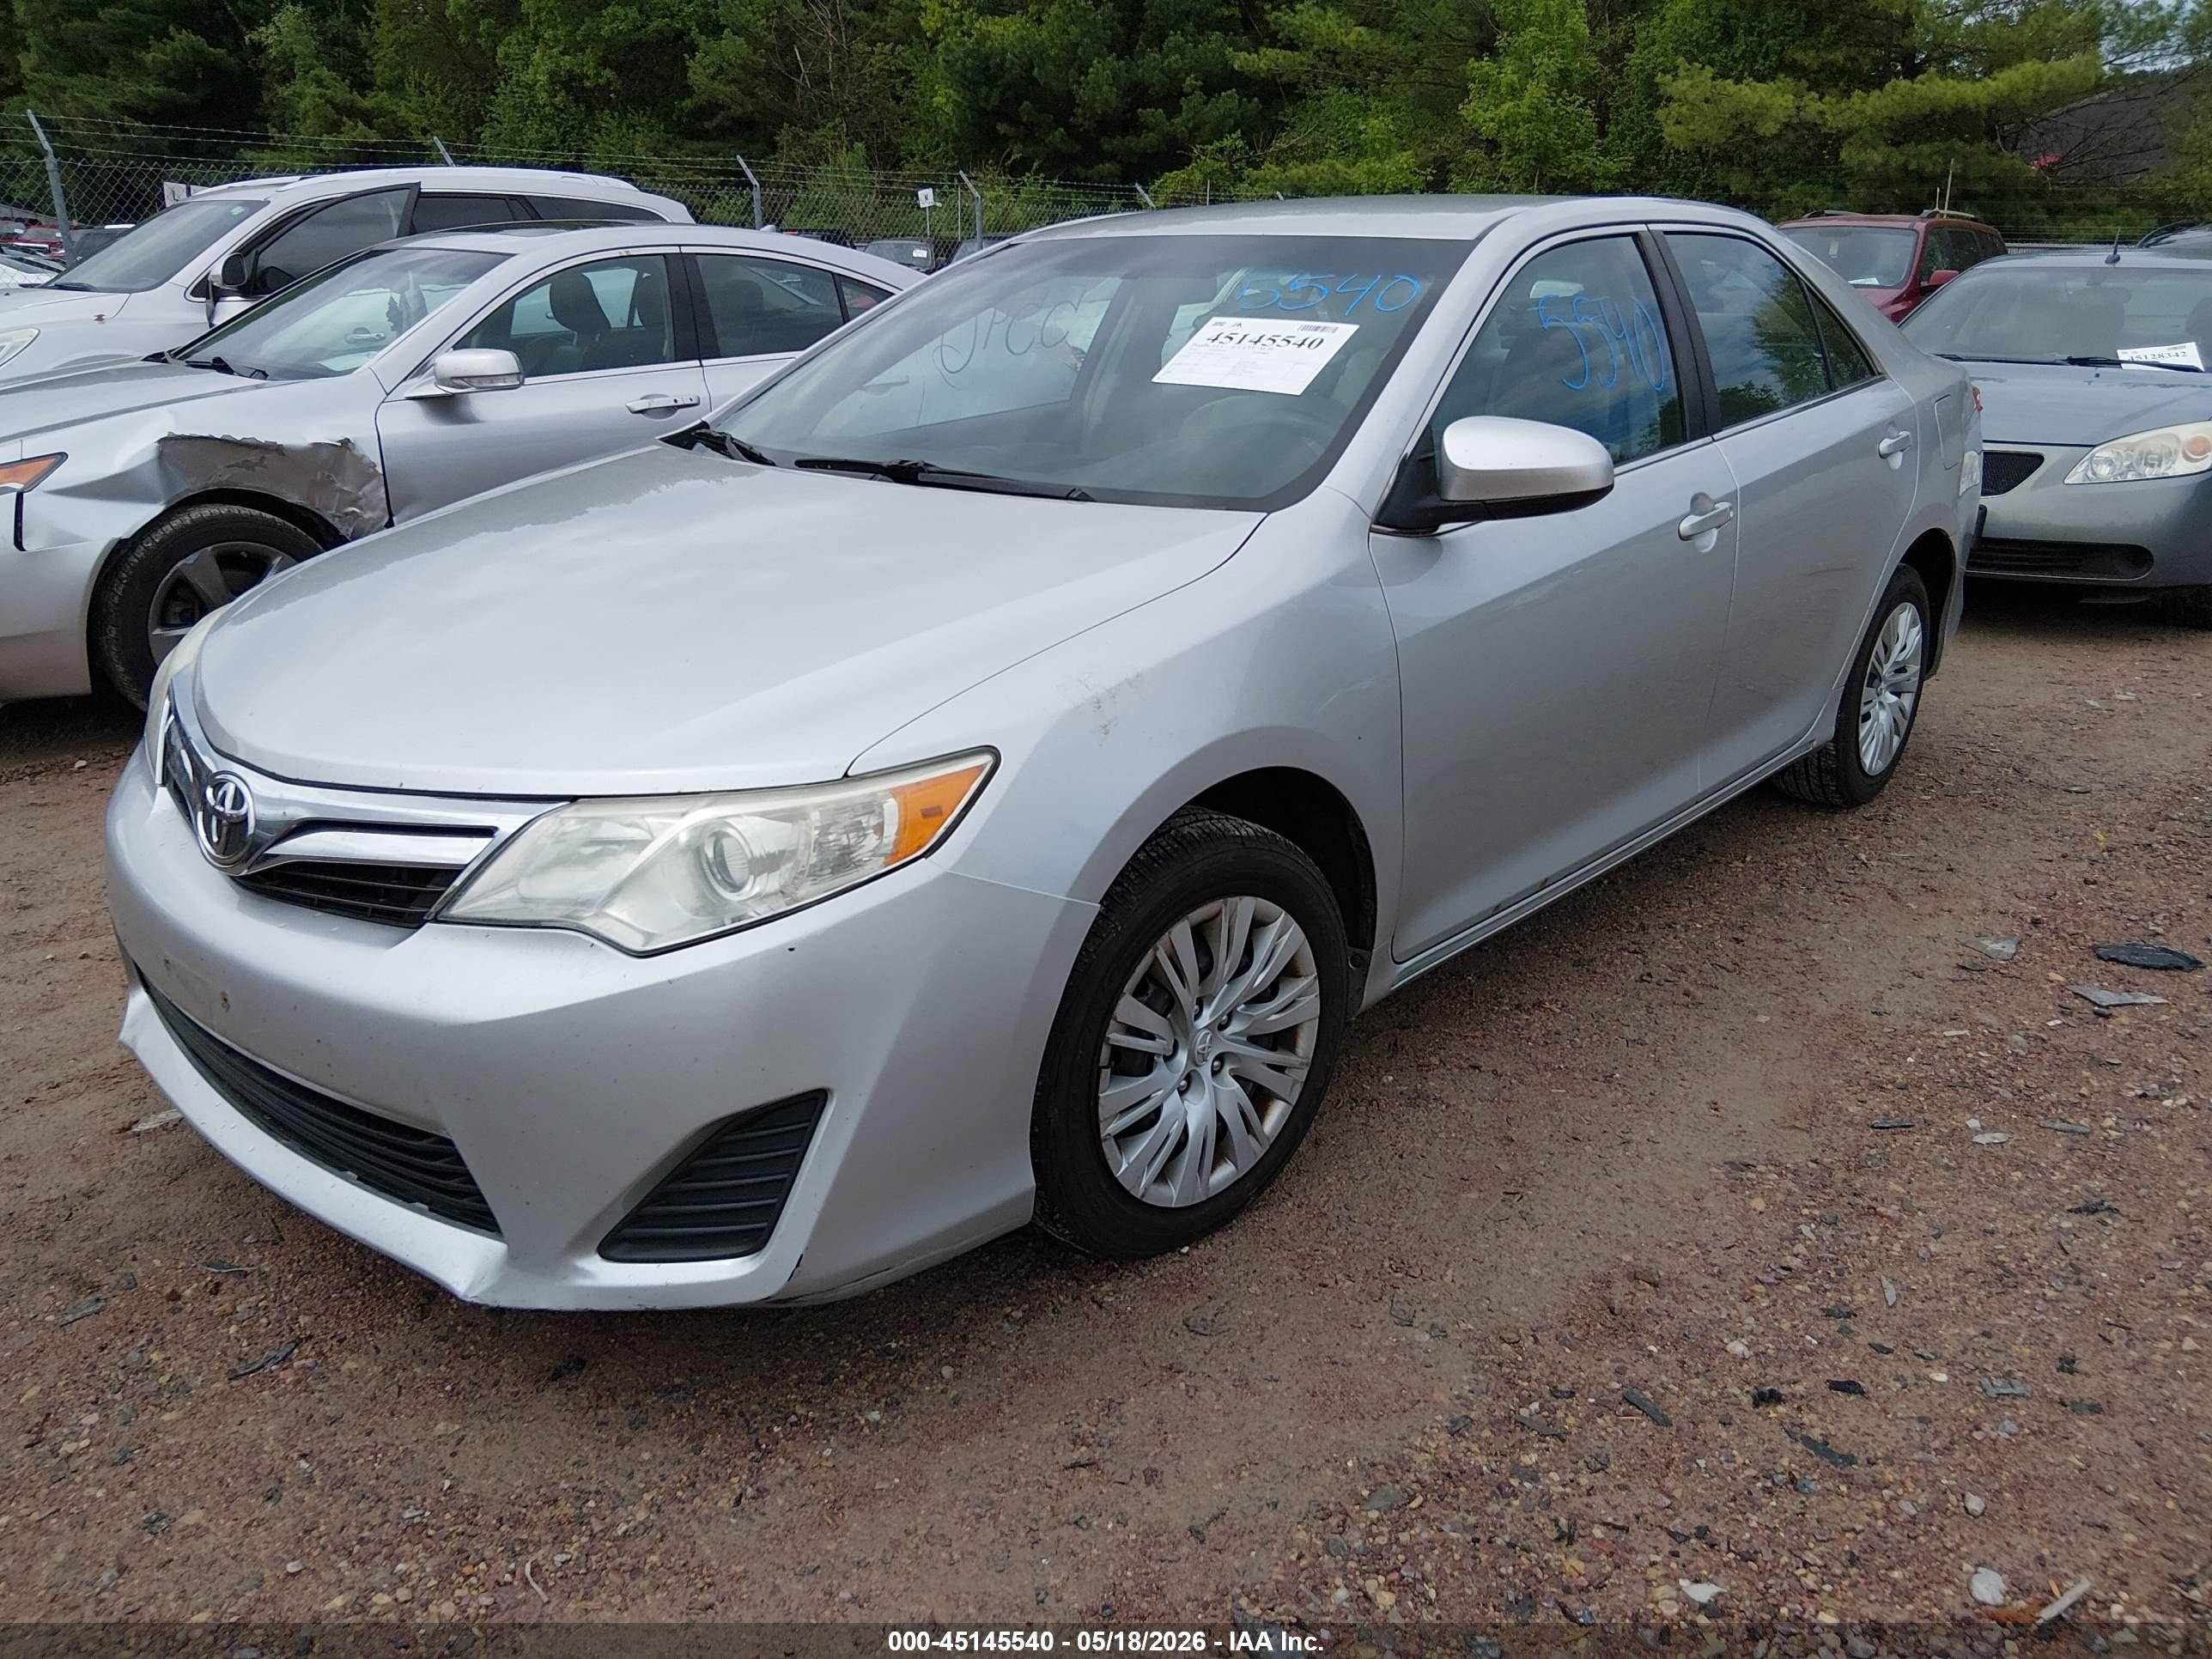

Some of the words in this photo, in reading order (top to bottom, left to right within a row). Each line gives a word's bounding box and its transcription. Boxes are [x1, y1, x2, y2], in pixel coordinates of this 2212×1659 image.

[1237, 273, 1421, 316] 5540
[1206, 331, 1325, 350] 45145540
[1537, 295, 1666, 392] 5540
